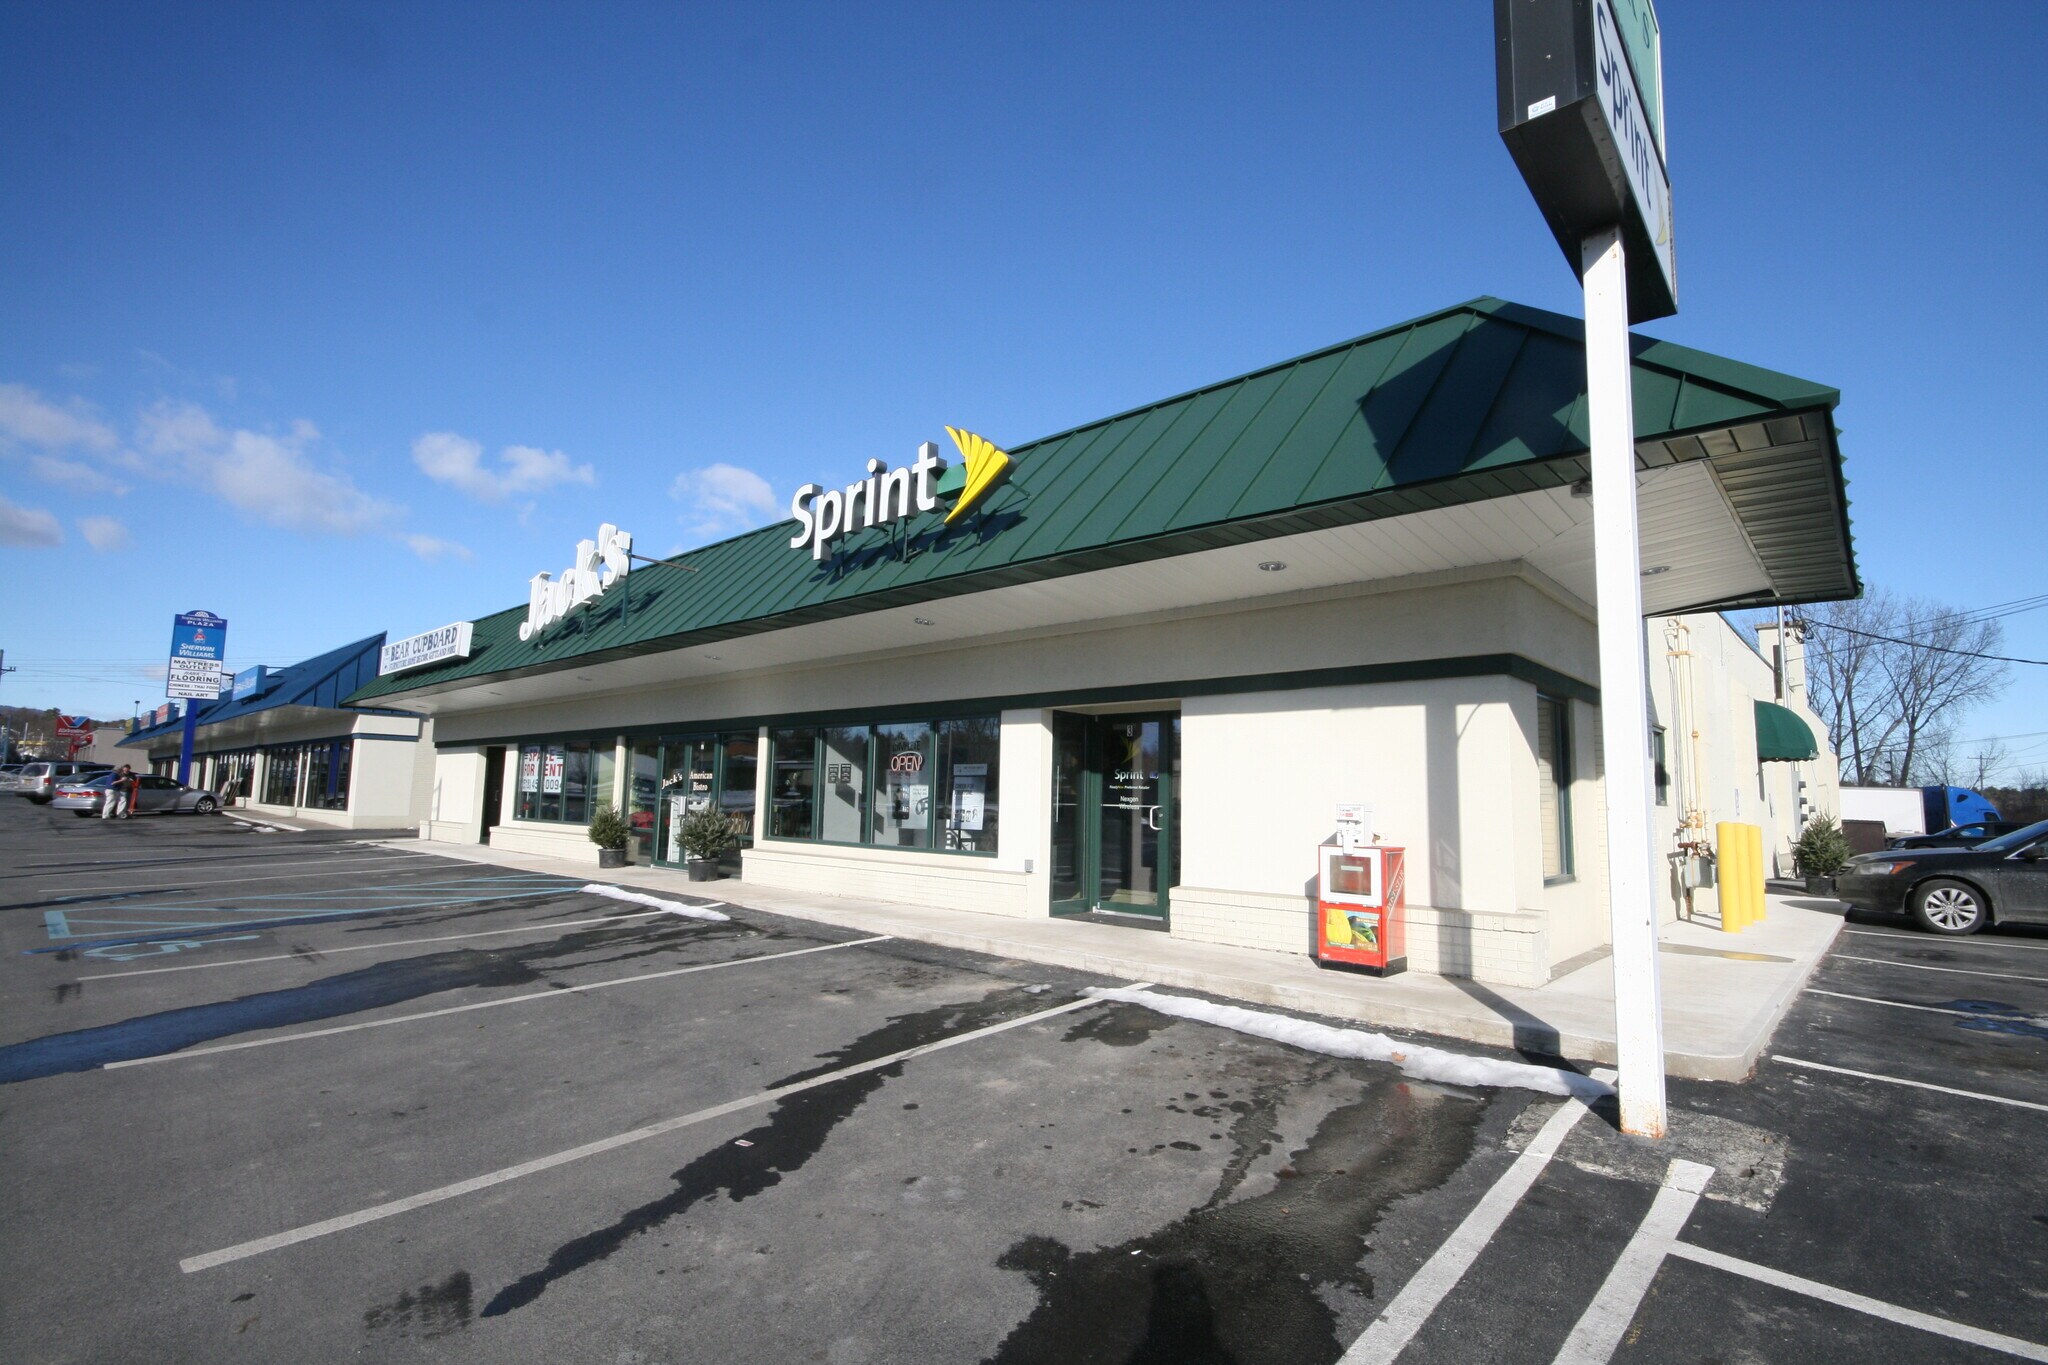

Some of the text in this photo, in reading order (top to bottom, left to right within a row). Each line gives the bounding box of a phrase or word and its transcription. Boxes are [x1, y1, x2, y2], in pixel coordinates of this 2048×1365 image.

[1597, 1, 1652, 210] Sprint
[790, 441, 945, 561] Sprint
[519, 523, 631, 641] Jack's
[181, 642, 215, 652] SHERWIN
[390, 627, 458, 662] BEAR CUPBOARD
[179, 650, 214, 658] WILLIAMS
[173, 660, 219, 668] MATTRESS
[170, 674, 219, 683] FLOORING
[524, 763, 535, 777] FOR
[543, 763, 564, 777] ENT
[891, 755, 920, 772] OPEN
[662, 773, 683, 790] Jack's
[689, 770, 714, 780] American
[1114, 768, 1144, 783] Sprint
[693, 781, 709, 791] Bistro
[1120, 795, 1139, 804] Nexgen
